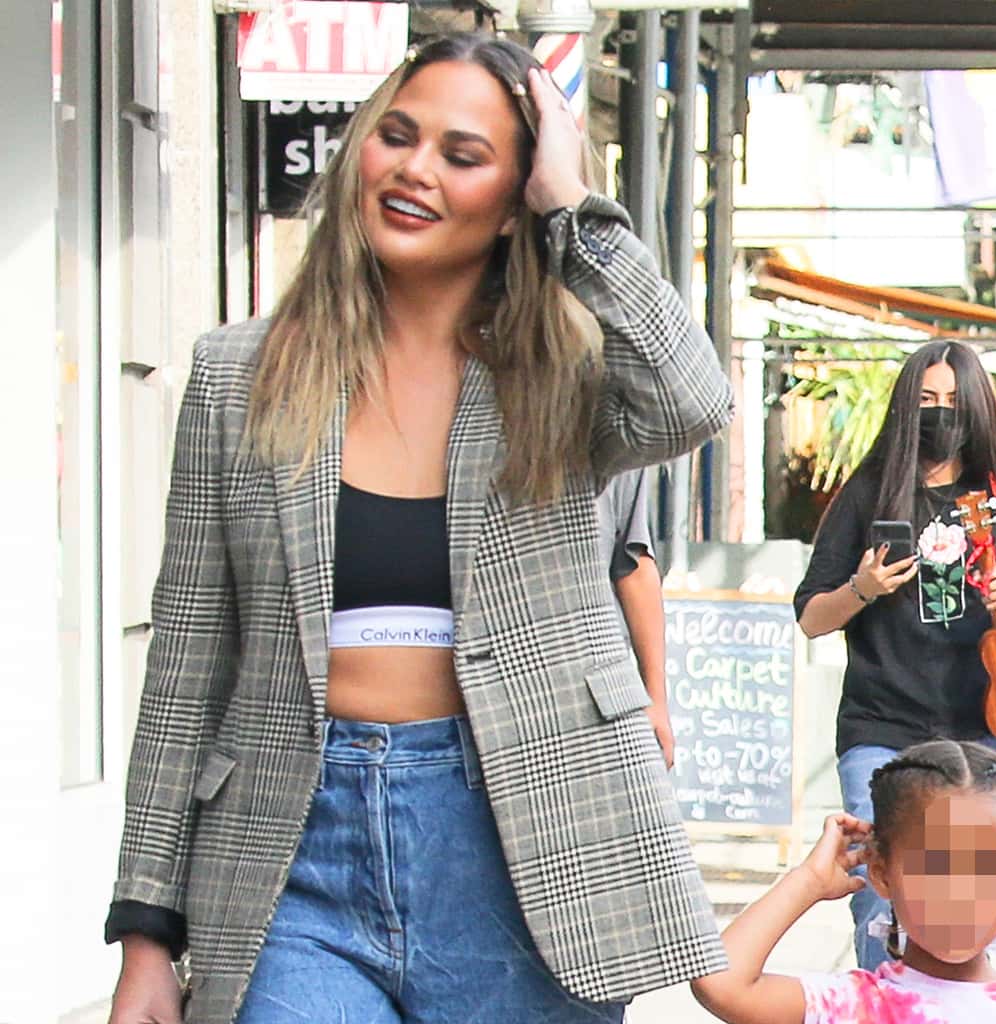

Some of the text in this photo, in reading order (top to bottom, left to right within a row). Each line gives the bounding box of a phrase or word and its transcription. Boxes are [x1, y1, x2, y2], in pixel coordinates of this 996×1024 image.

[240, 2, 405, 73] ATM
[686, 647, 790, 690] Carpet
[675, 679, 789, 717] Culture
[701, 710, 768, 738] Sales
